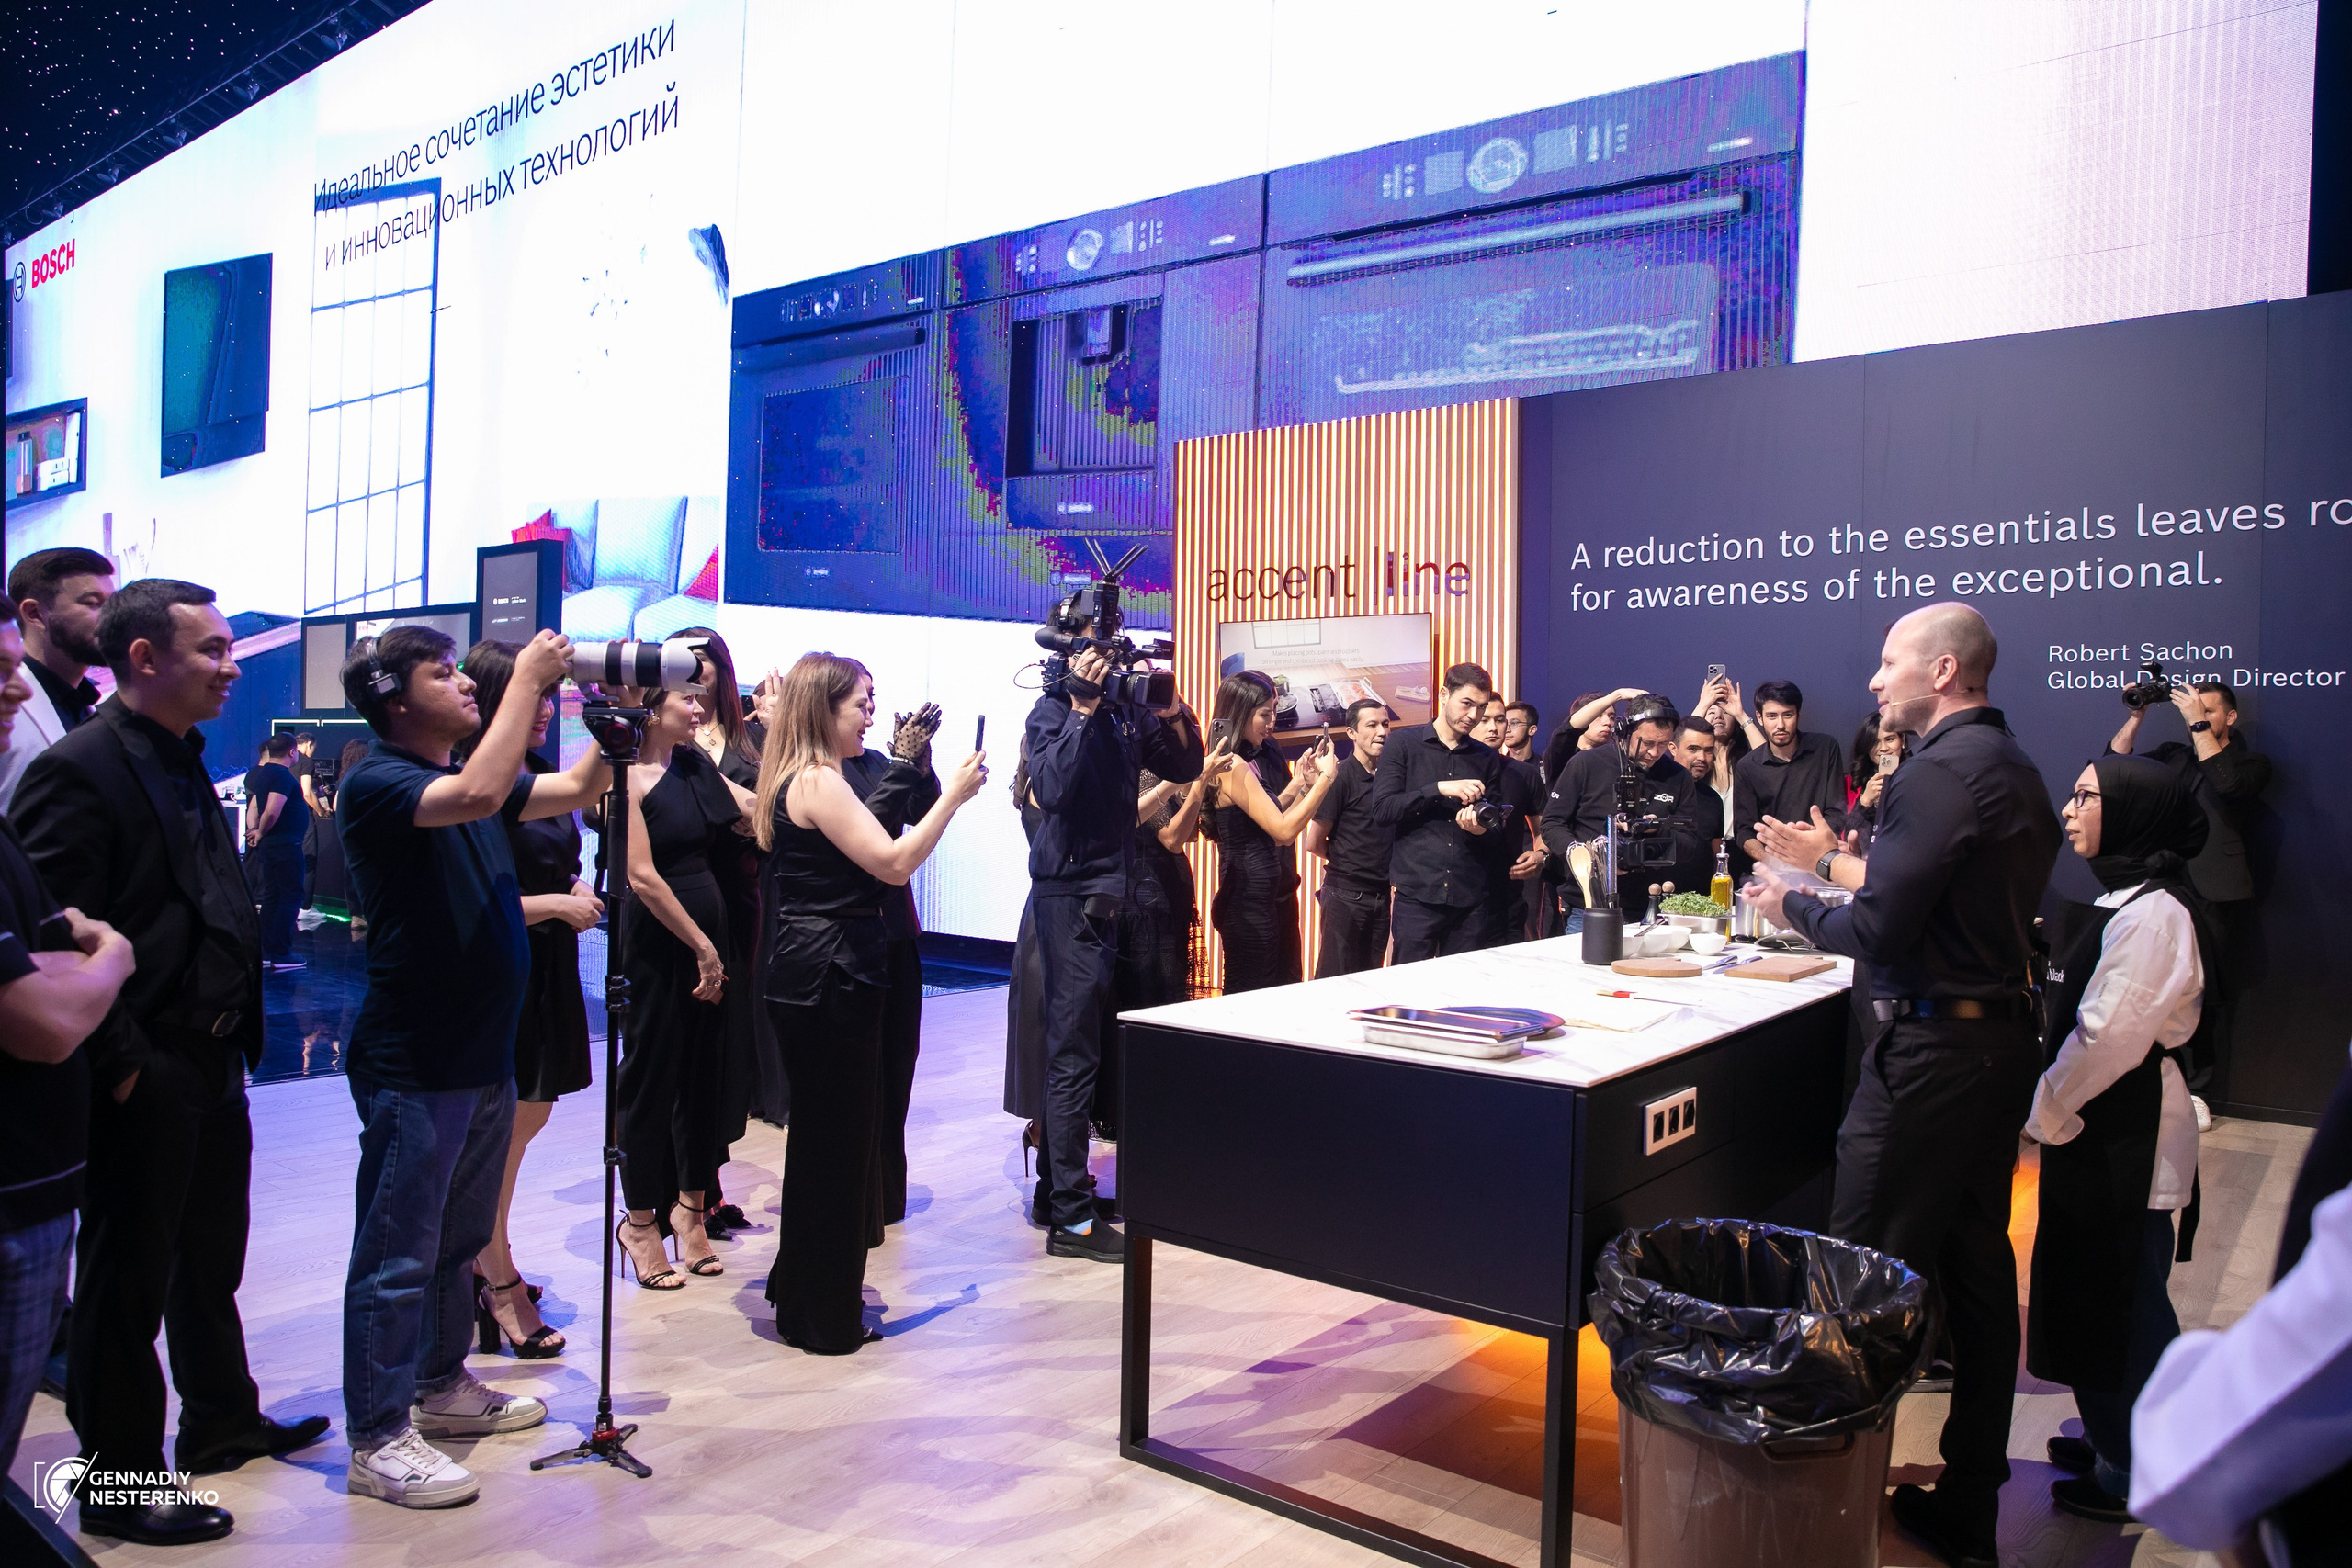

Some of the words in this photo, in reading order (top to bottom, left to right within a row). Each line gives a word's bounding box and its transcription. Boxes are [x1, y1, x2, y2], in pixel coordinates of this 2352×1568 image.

[314, 143, 421, 217] Идеальное
[425, 83, 545, 164] сочетание
[551, 19, 675, 106] эстетики
[325, 243, 336, 270] и
[342, 164, 515, 265] инновационных
[519, 81, 679, 189] технологий
[31, 238, 75, 288] BOSCH
[1570, 542, 1592, 570] A
[1604, 532, 1764, 568] reduction
[1779, 530, 1815, 558] to
[1828, 523, 1889, 554] the
[1905, 506, 2116, 549] essentials
[2137, 502, 2285, 537] leaves
[2310, 499, 2352, 526] ro
[1206, 554, 1357, 603] accent
[1386, 551, 1471, 597] line
[1571, 582, 1616, 612] for
[1626, 580, 1808, 608] awareness
[1824, 568, 1861, 601] of
[1873, 566, 1936, 599] the
[1951, 550, 2222, 599] exceptional.
[2047, 670, 2126, 689] Global
[2233, 667, 2346, 687] Director
[2049, 643, 2131, 663] Robert
[2140, 640, 2233, 660] Sachon
